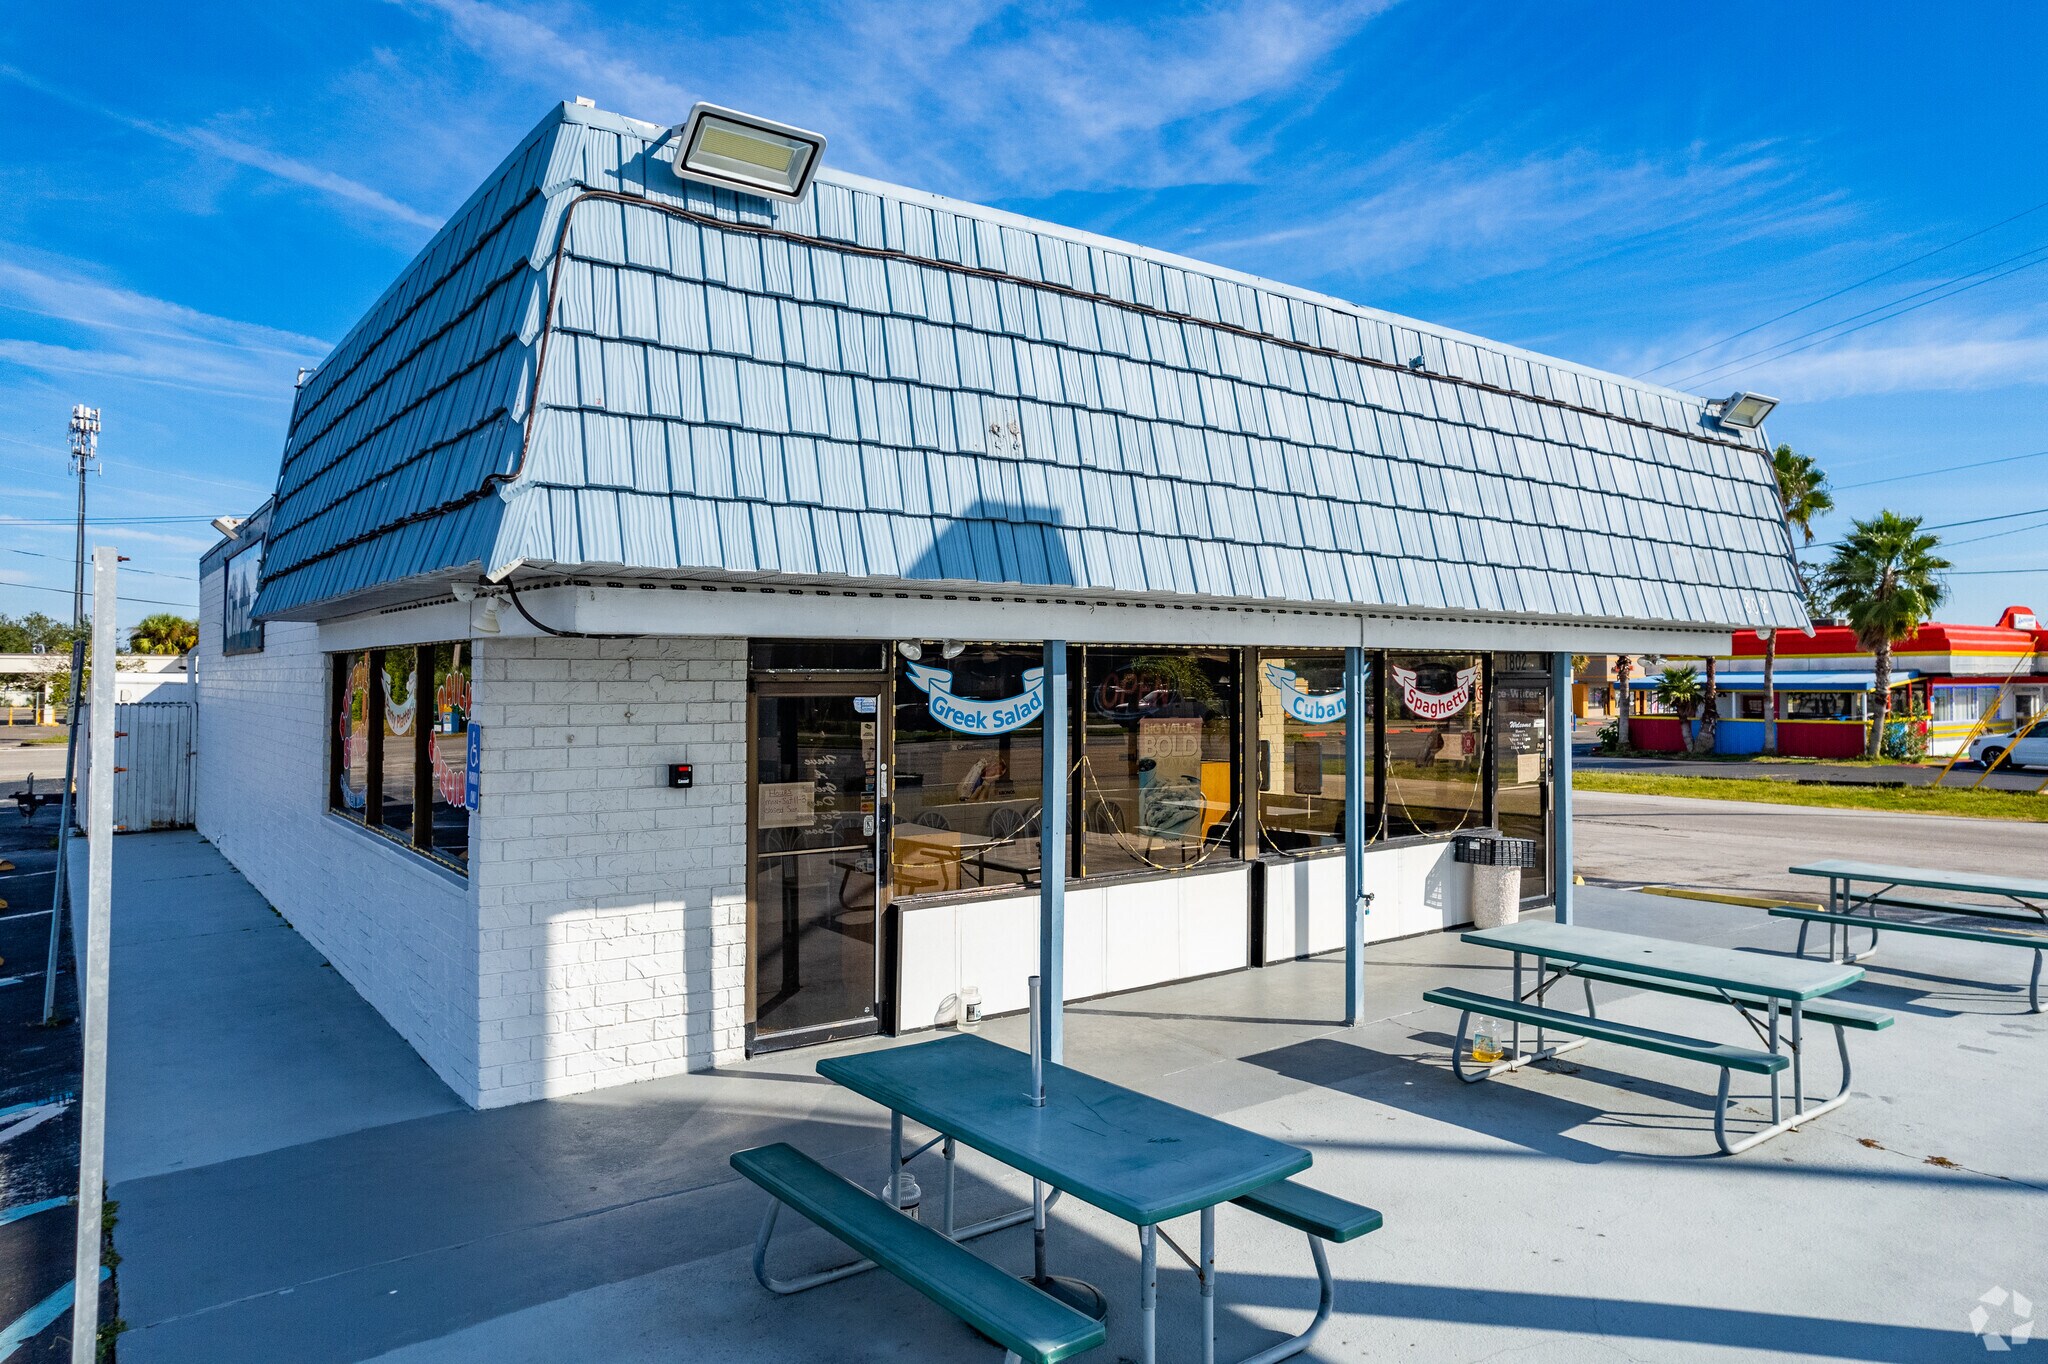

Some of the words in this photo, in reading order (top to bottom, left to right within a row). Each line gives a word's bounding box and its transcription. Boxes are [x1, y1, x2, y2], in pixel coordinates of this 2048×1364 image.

[1504, 653, 1527, 671] 1802
[1100, 671, 1169, 711] OPEN
[1406, 686, 1467, 718] Spaghetti
[931, 696, 988, 729] Greek
[992, 690, 1043, 729] Salad
[1293, 696, 1347, 719] Cuban
[1144, 722, 1162, 735] BIG
[1144, 734, 1198, 758] BOLD
[428, 728, 468, 808] SPECIA
